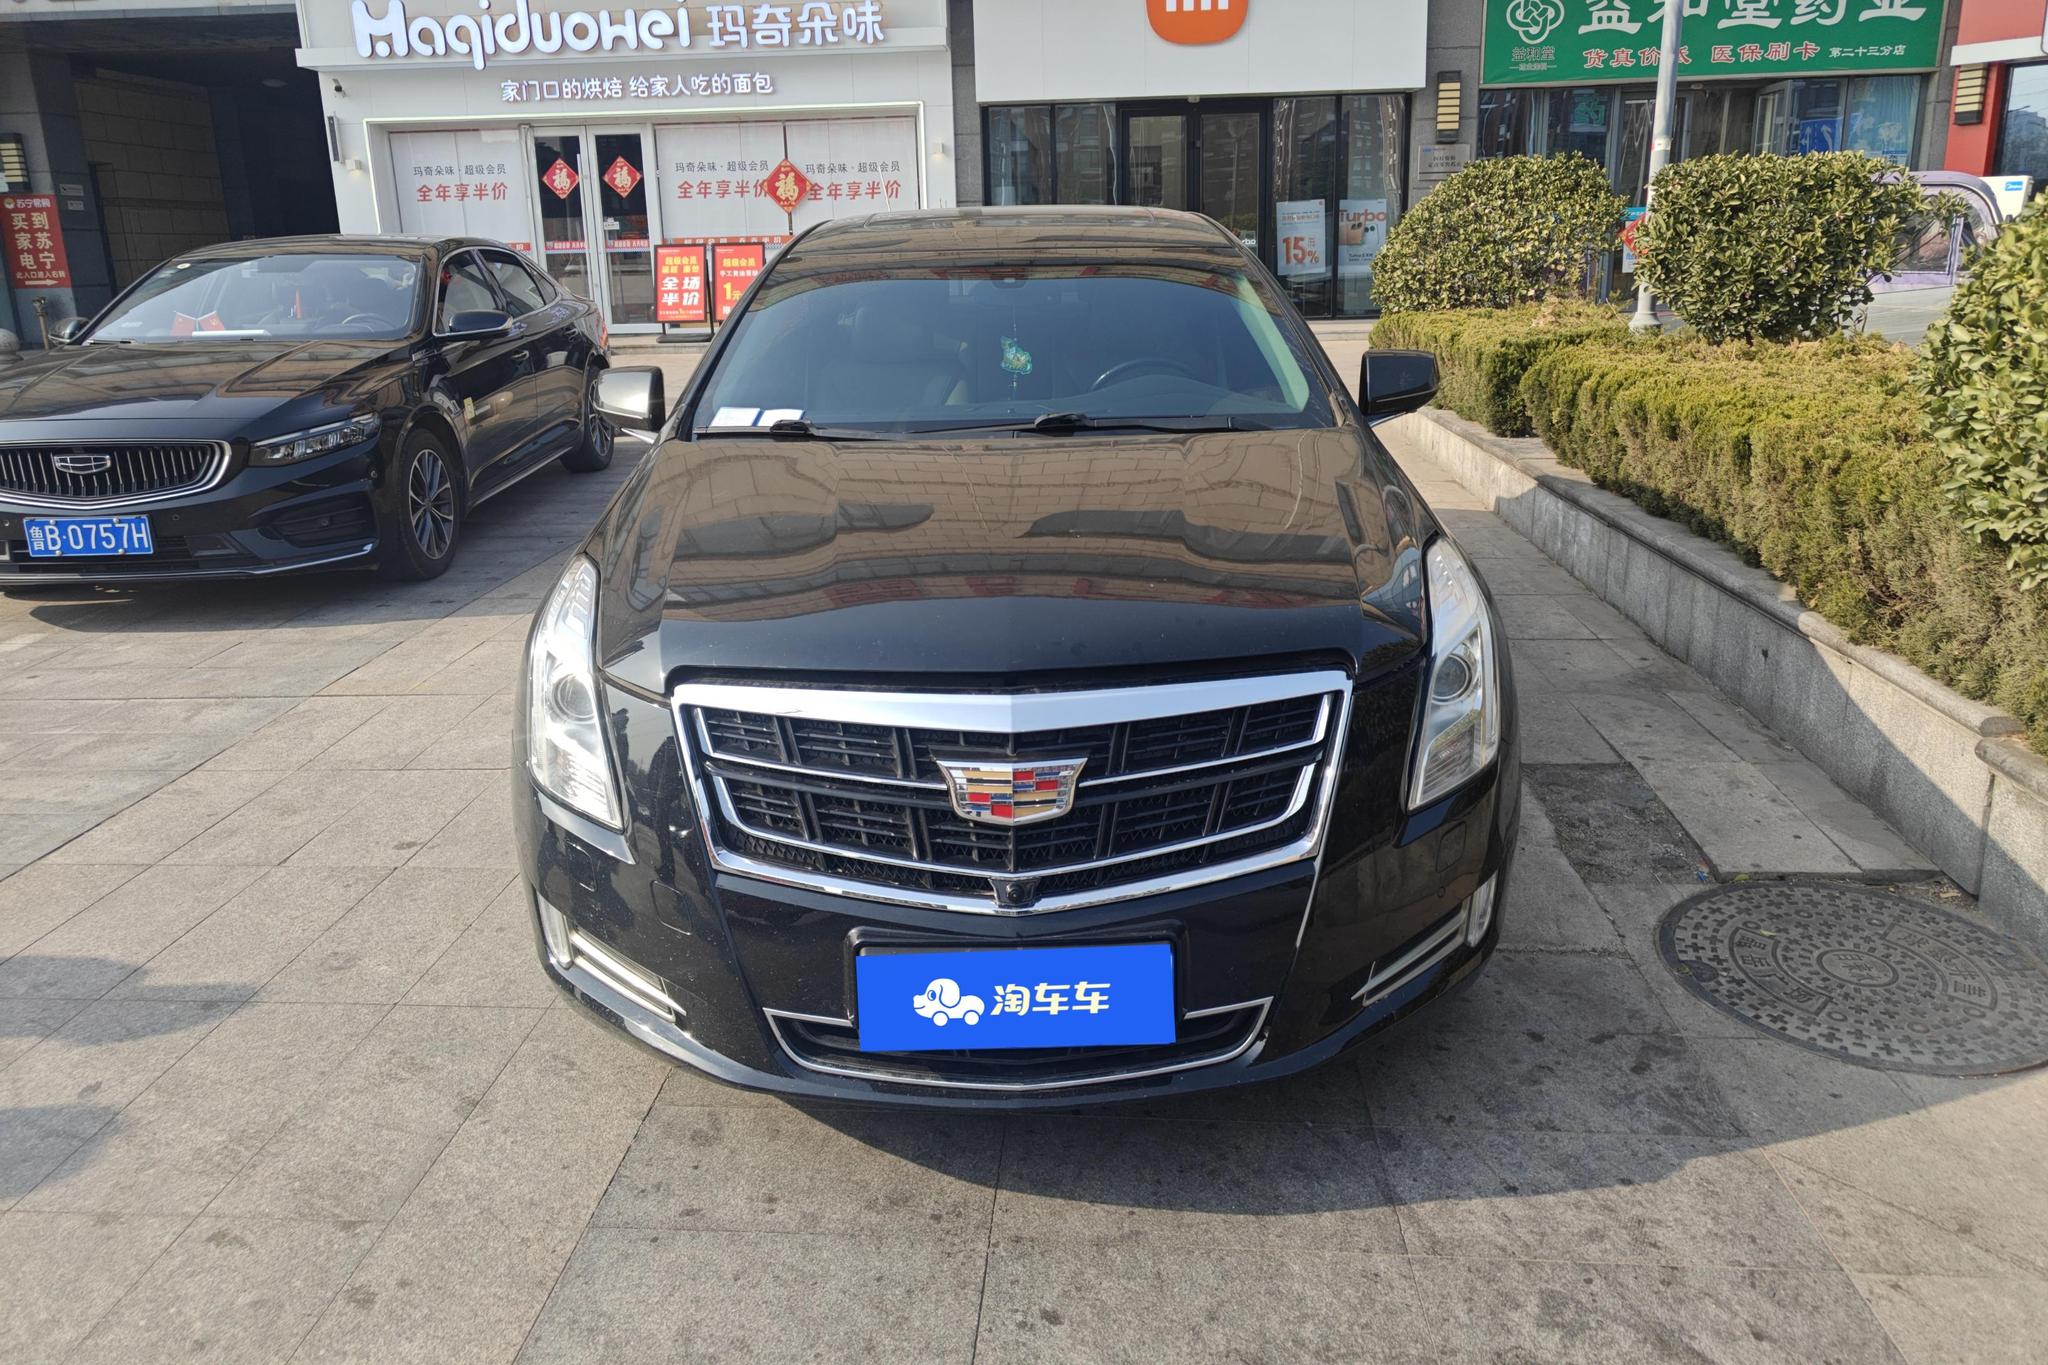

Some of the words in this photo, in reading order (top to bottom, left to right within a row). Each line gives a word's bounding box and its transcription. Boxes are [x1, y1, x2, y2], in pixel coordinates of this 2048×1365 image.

[706, 0, 884, 48] 玛奇朵味
[1578, 0, 1927, 35] 益堂药
[1711, 41, 1820, 63] 医保刷卡
[1828, 44, 1907, 58] 第二十三分店
[500, 77, 623, 102] 家门口的烘焙
[629, 72, 775, 97] 给家人吃的面包
[416, 182, 508, 202] 全年享半价
[775, 171, 799, 201] 福
[808, 180, 901, 201] 全年享半价
[1340, 209, 1386, 223] Turbo
[1282, 236, 1320, 265] 15%
[661, 276, 701, 290] 全场
[661, 291, 700, 306] 半价
[30, 522, 149, 552] 鲁B·0757H
